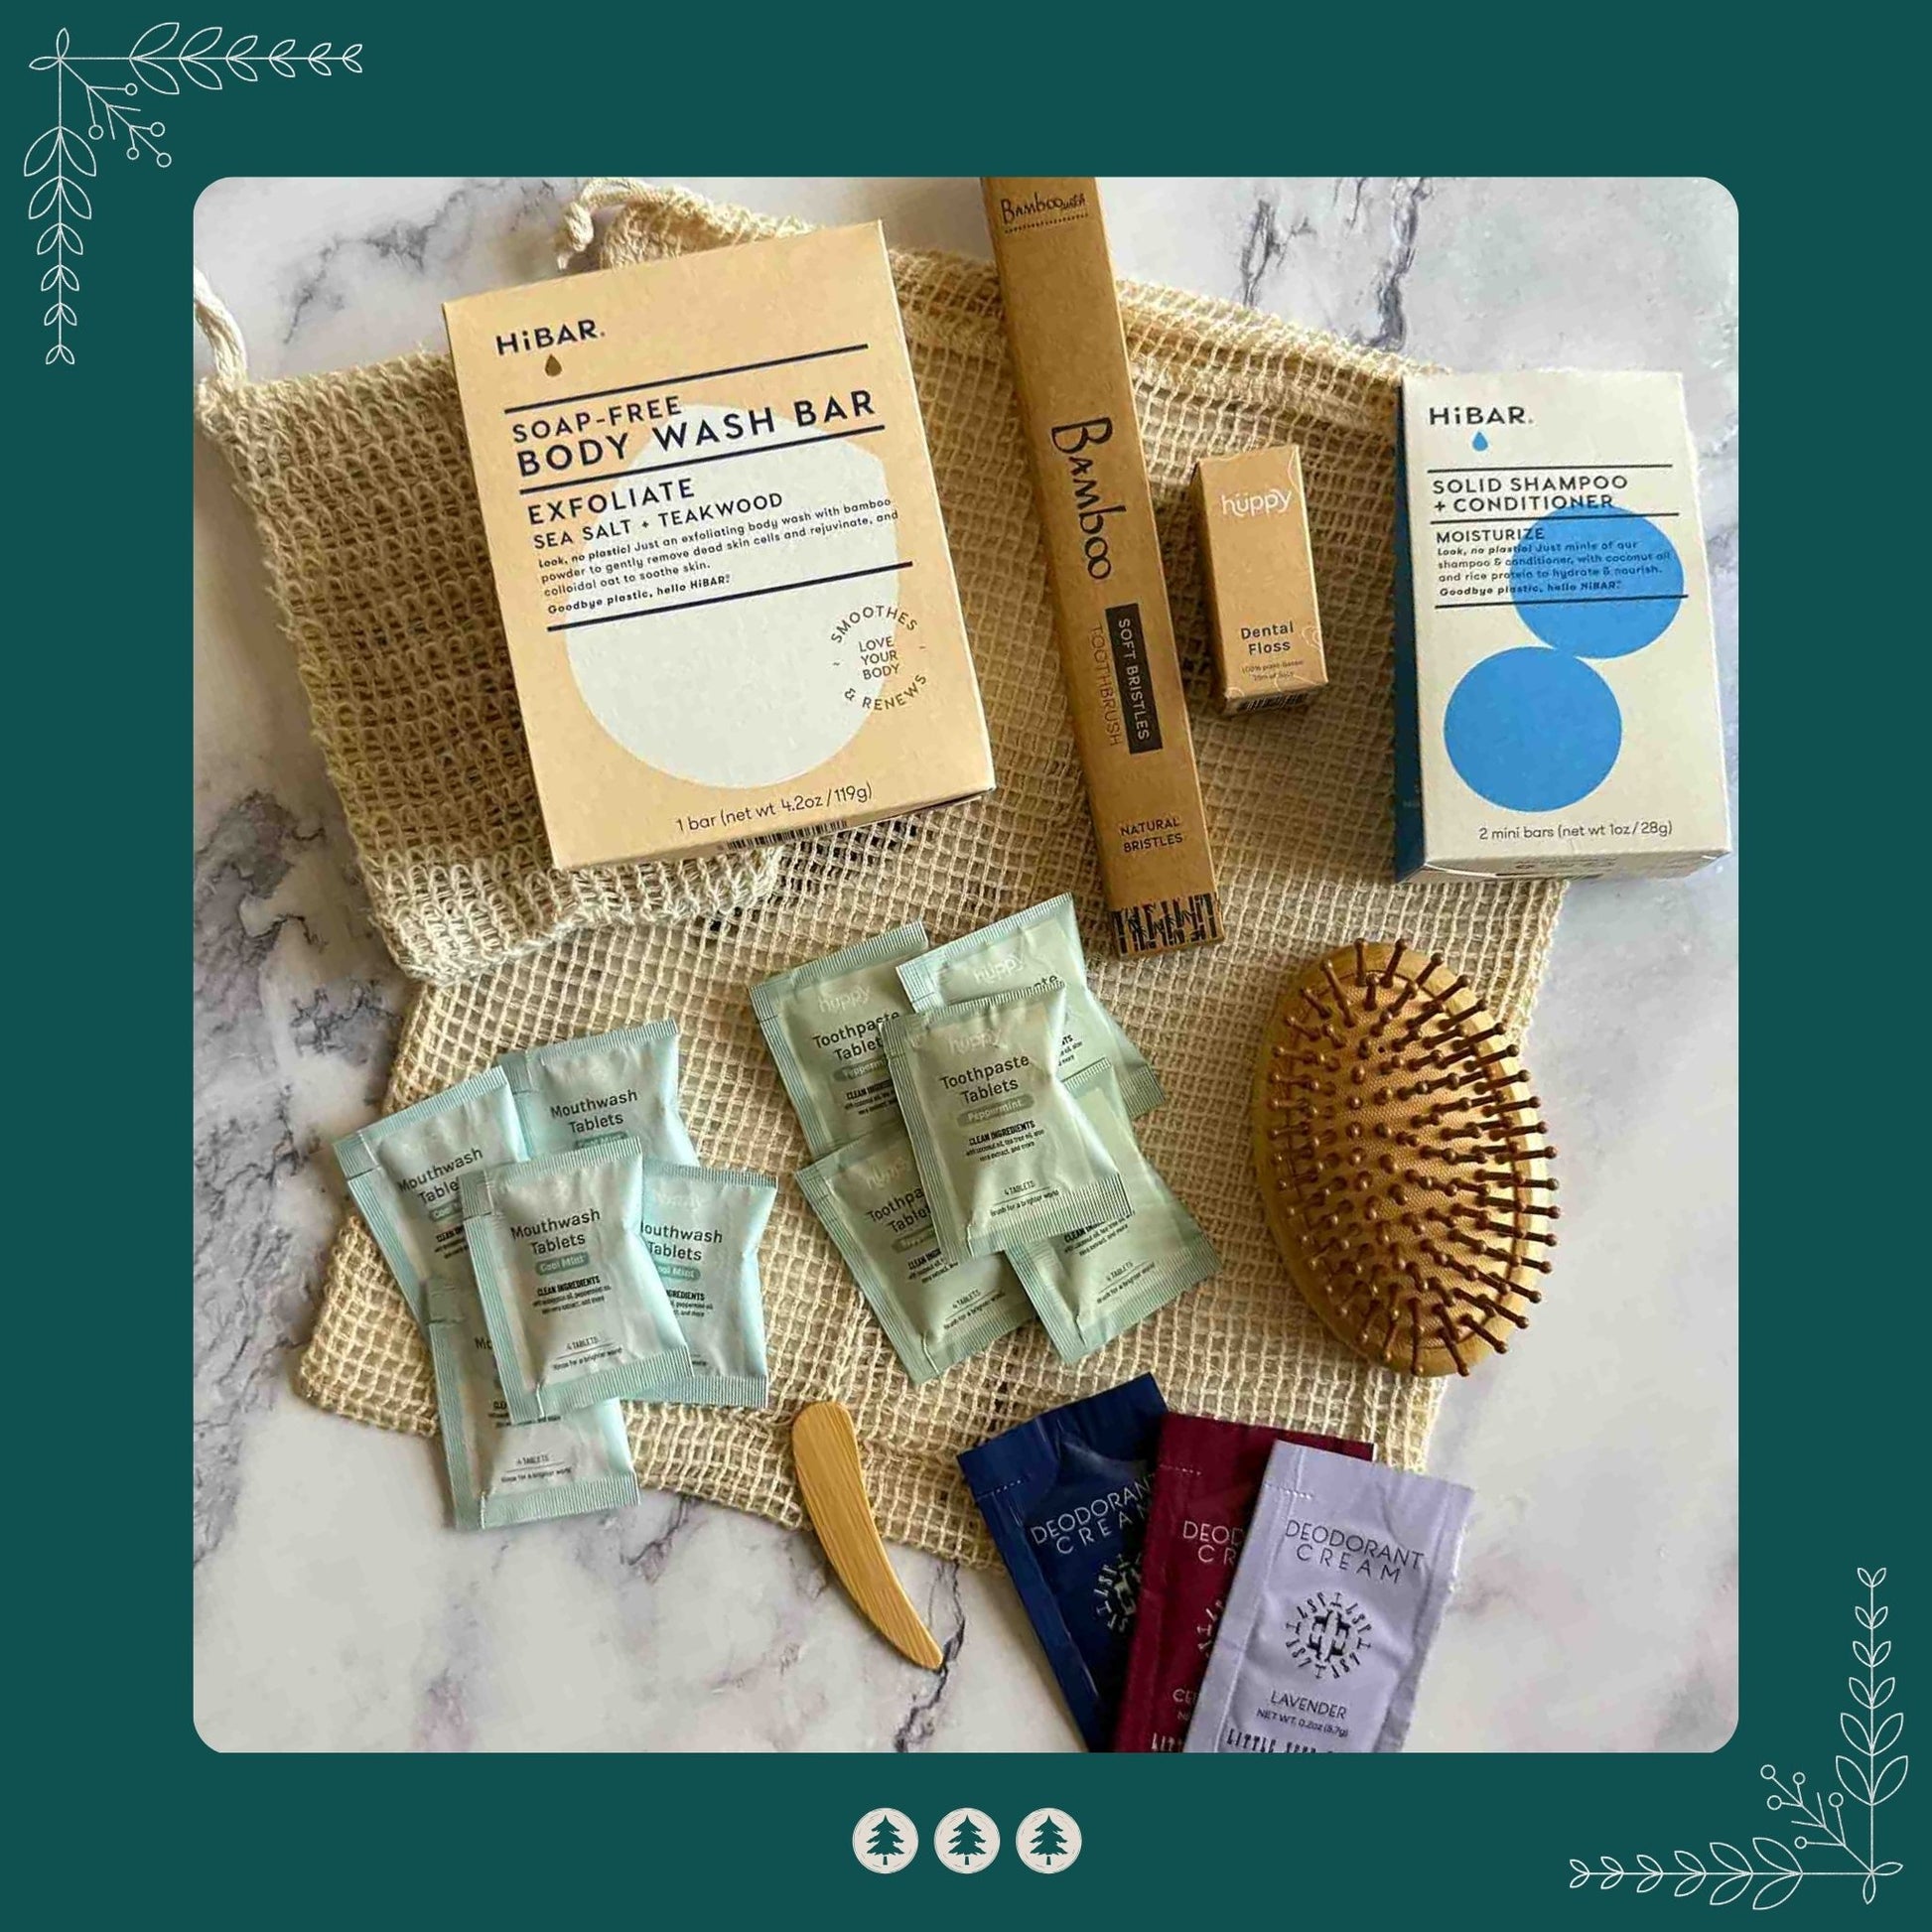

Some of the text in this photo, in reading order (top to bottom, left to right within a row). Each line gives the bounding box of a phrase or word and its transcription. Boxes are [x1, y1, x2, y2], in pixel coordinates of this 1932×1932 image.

[512, 395, 682, 444] SOAP-FREE
[518, 389, 876, 478] BODY WASH BAR
[1433, 475, 1628, 494] SOLID SHAMPOO
[527, 479, 695, 525] EXFOLIATE
[1453, 493, 1614, 513] CONDITIONER
[534, 531, 573, 549] SEA
[583, 519, 631, 541] SALT
[658, 492, 782, 527] TEAKWOOD
[539, 498, 891, 568] Look, no plastic! Just an exfoliating body wash with bamboo
[541, 568, 587, 585] powder
[590, 565, 602, 575] to
[606, 557, 643, 575] gently
[647, 549, 689, 564] remove
[693, 542, 723, 556] dead
[727, 539, 750, 551] skin
[754, 532, 780, 545] cells
[784, 529, 806, 540] and
[877, 510, 898, 522] and
[1437, 527, 1545, 543] MOISTURIZE
[1438, 547, 1467, 556] Look,
[1439, 560, 1490, 569] shampoo
[544, 562, 711, 597] colloidal oat to soothe skin.
[1439, 573, 1460, 583] and
[1464, 572, 1486, 581] rice
[1440, 586, 1493, 597] Goodbye
[548, 598, 603, 615] Goodbye
[607, 590, 653, 606] plastic,
[657, 584, 686, 596] hello
[831, 605, 917, 643] SMOOTHES
[1241, 621, 1294, 639] Dental
[859, 636, 894, 652] LOVE
[860, 650, 898, 665] YOUR
[1248, 639, 1291, 655] Floss
[863, 663, 899, 680] BODY
[1090, 624, 1122, 747] TOOTHBRUSH
[1118, 618, 1151, 742] SOFT BRISTLES
[862, 673, 927, 711] RENEWS
[676, 819, 683, 832] 1
[688, 815, 717, 831] bar
[721, 808, 752, 827] (net
[756, 803, 776, 817] wt
[1120, 817, 1180, 837] NATURAL
[1123, 832, 1183, 853] BRISTLES
[1478, 827, 1488, 840] 2
[1492, 826, 1519, 839] mini
[1524, 826, 1554, 838] bars
[1558, 824, 1585, 838] (net
[1588, 825, 1605, 836] wt
[834, 1036, 884, 1061] Tablet
[939, 1055, 1030, 1090] Toothpaste
[550, 1089, 638, 1119] Mouthwash
[960, 1078, 1019, 1105] Tablets
[567, 1112, 623, 1134] Tablets
[397, 1147, 483, 1193] Mouthwash
[419, 1176, 460, 1204] Table
[866, 1186, 925, 1222] Toothpa
[510, 1208, 601, 1240] Mouthwash
[887, 1204, 931, 1233] Table
[530, 1233, 586, 1256] Tablets
[647, 1241, 702, 1261] Tablets
[666, 1290, 705, 1302] GREDIENTS
[1031, 1474, 1153, 1546] DEODORAN
[1285, 1519, 1425, 1571] DEODORANT
[1296, 1543, 1401, 1585] CREAM
[1256, 1708, 1277, 1720] NET
[1270, 1690, 1346, 1720] LAVENDER
